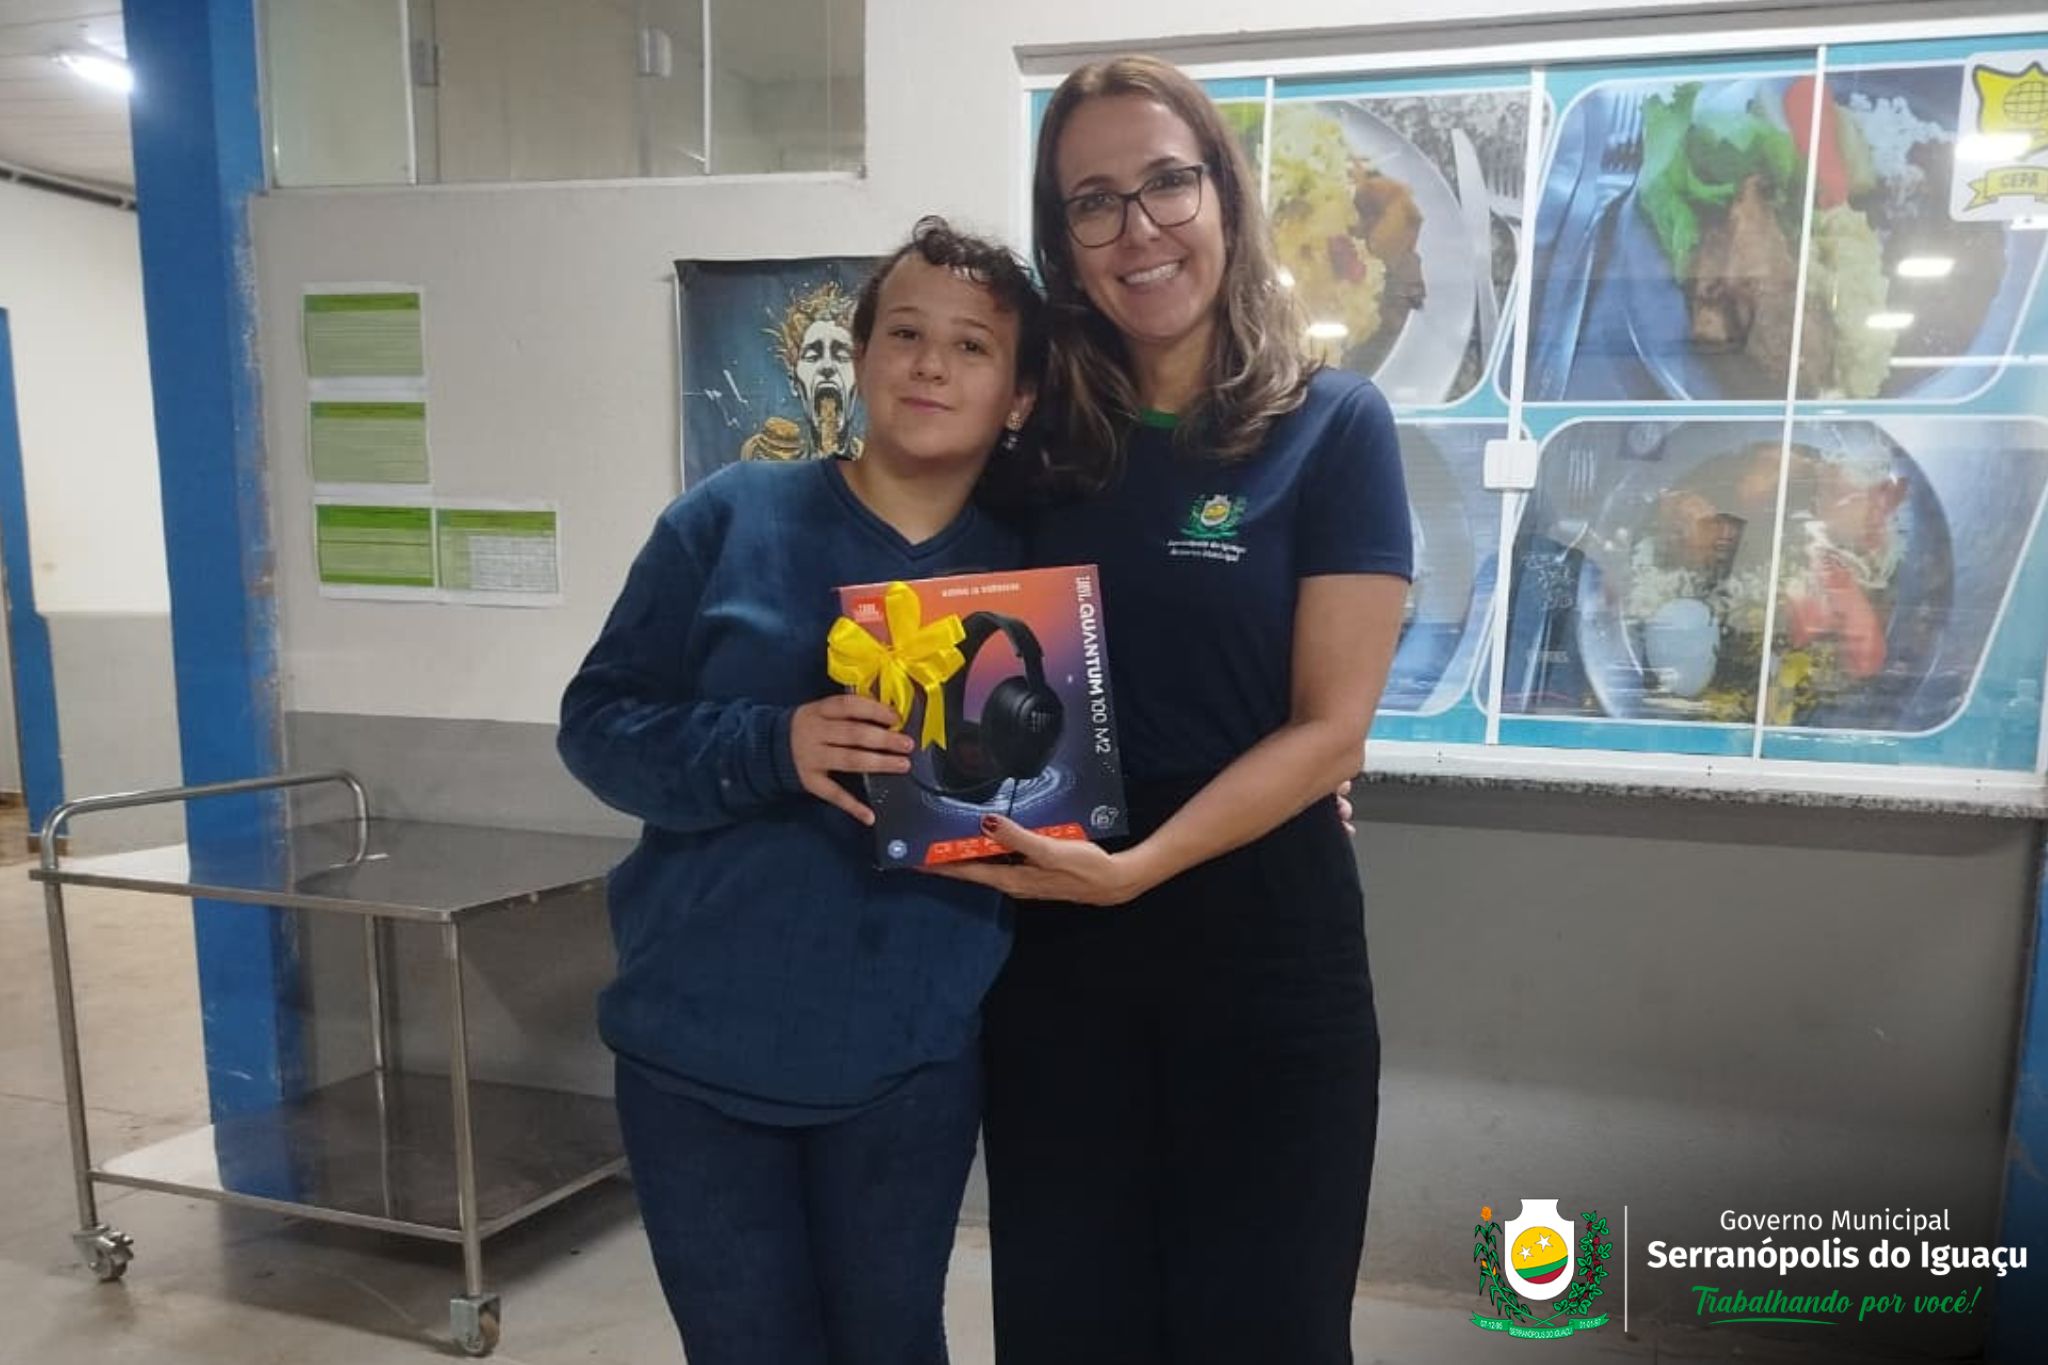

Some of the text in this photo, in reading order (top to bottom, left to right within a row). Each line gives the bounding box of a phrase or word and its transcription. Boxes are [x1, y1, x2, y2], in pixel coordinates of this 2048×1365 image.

[1080, 603, 1104, 696] QUANTUM
[1091, 697, 1108, 724] 100
[1094, 727, 1112, 754] M2
